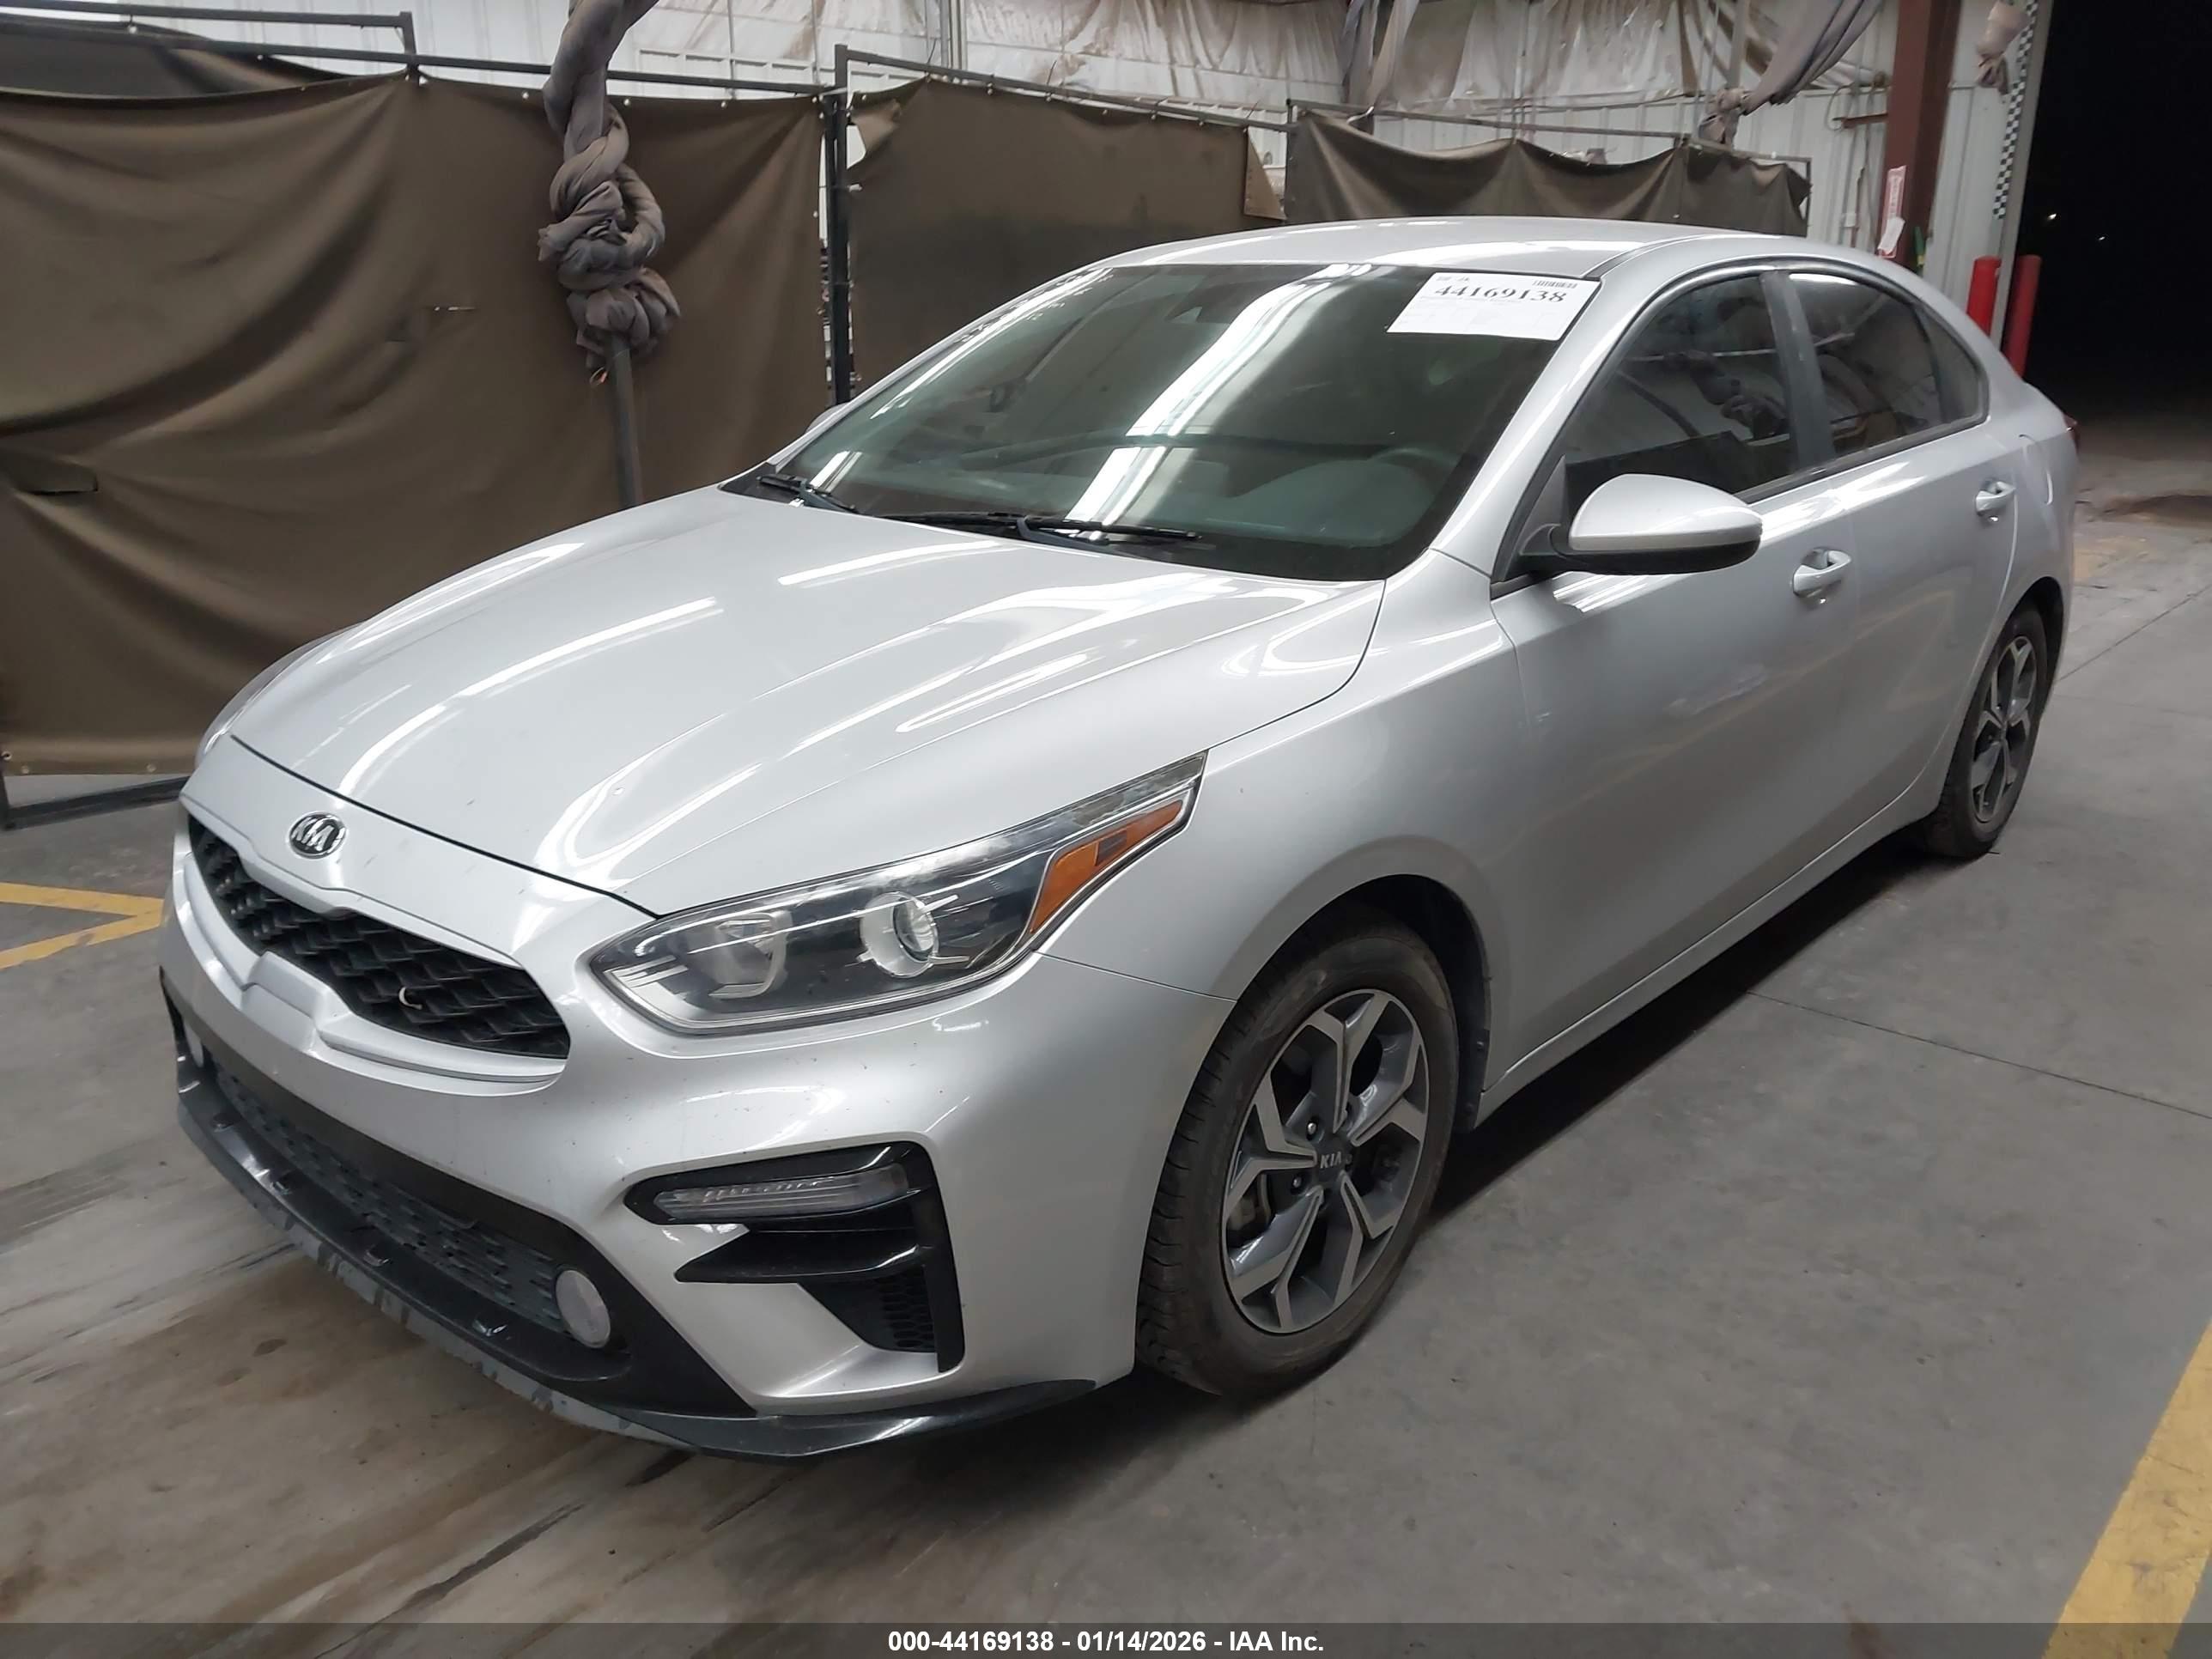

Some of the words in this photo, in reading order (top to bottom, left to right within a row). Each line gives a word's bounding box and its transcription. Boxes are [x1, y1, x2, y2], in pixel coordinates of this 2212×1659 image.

[1435, 285, 1566, 301] 44169138
[291, 816, 336, 852] KIA
[1320, 1151, 1342, 1169] KIA
